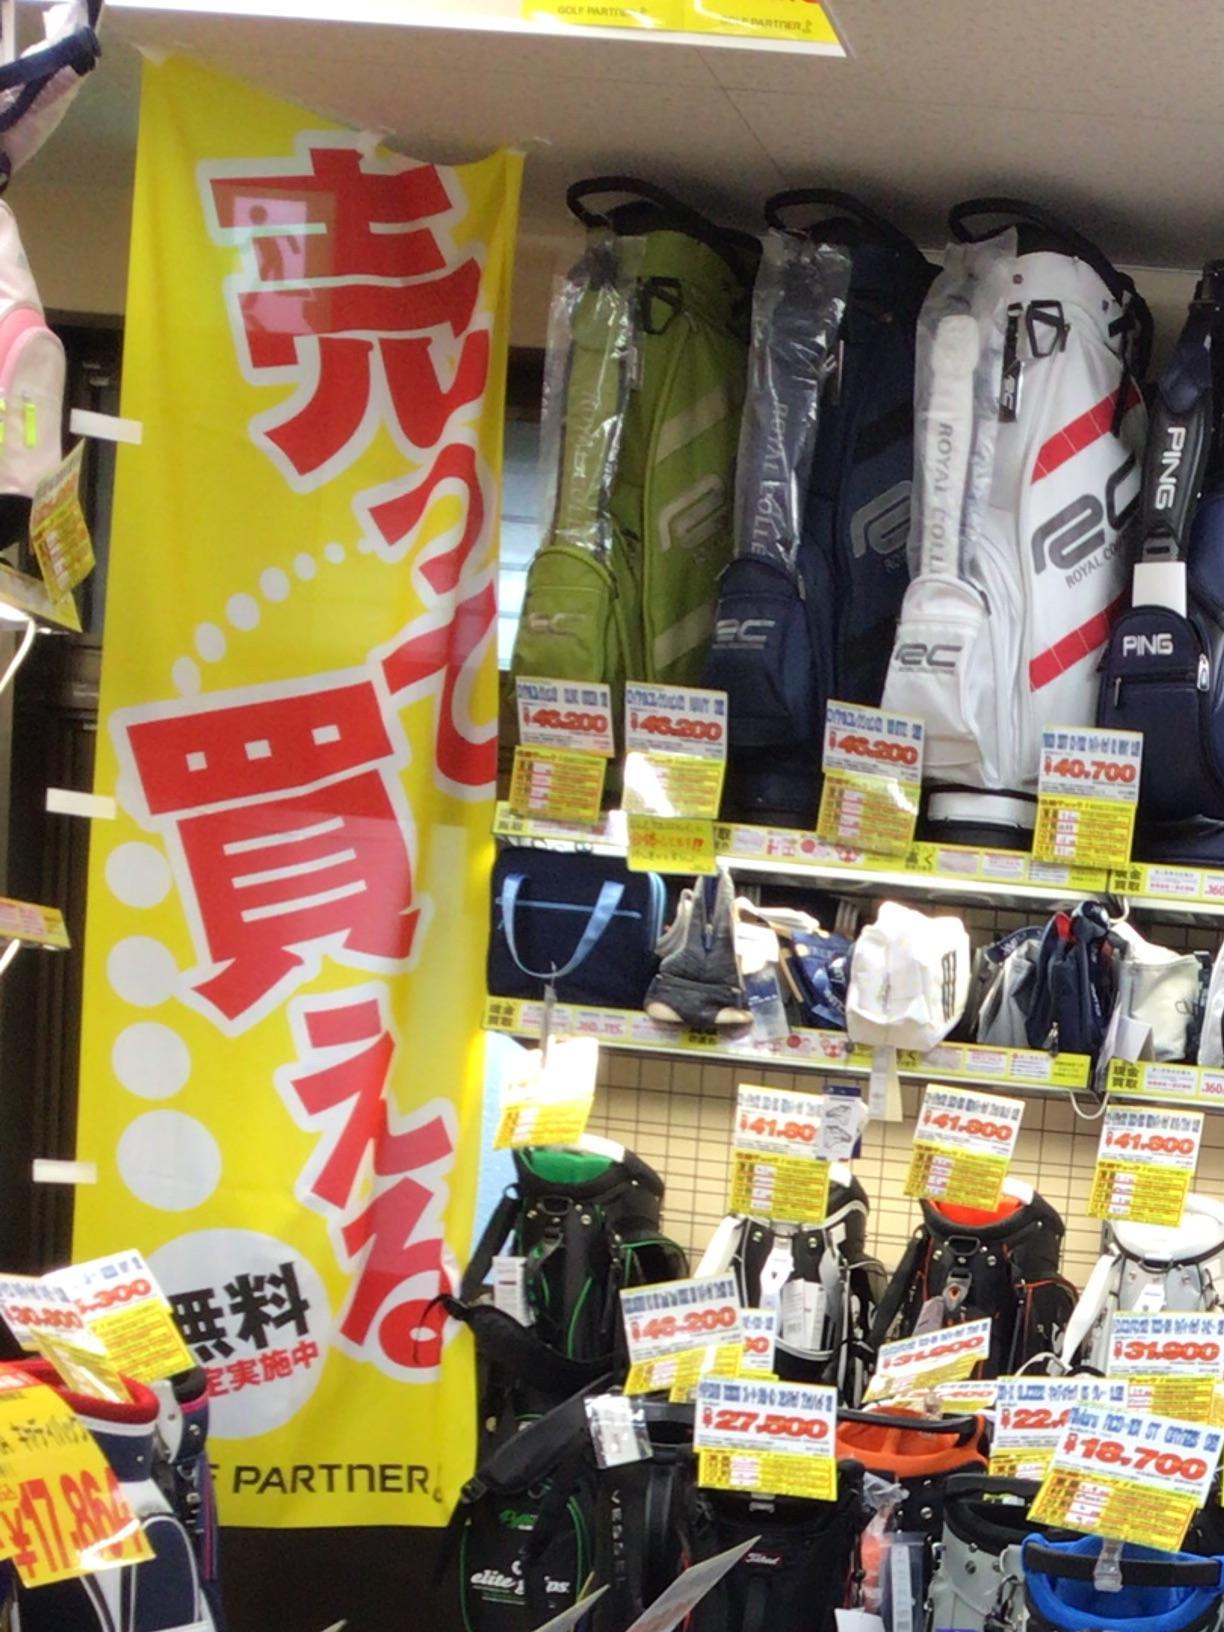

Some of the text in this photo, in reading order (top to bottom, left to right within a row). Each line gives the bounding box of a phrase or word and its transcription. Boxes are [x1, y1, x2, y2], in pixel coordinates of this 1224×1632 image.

[1155, 426, 1187, 511] PING
[1064, 556, 1103, 590] ROYAL
[1122, 633, 1174, 657] PING
[170, 1262, 310, 1363] 無料
[702, 1406, 830, 1440] ¥27,500
[1063, 1431, 1209, 1482] ¥18,700
[232, 1463, 430, 1495] PARTNER
[470, 1568, 515, 1588] elite
